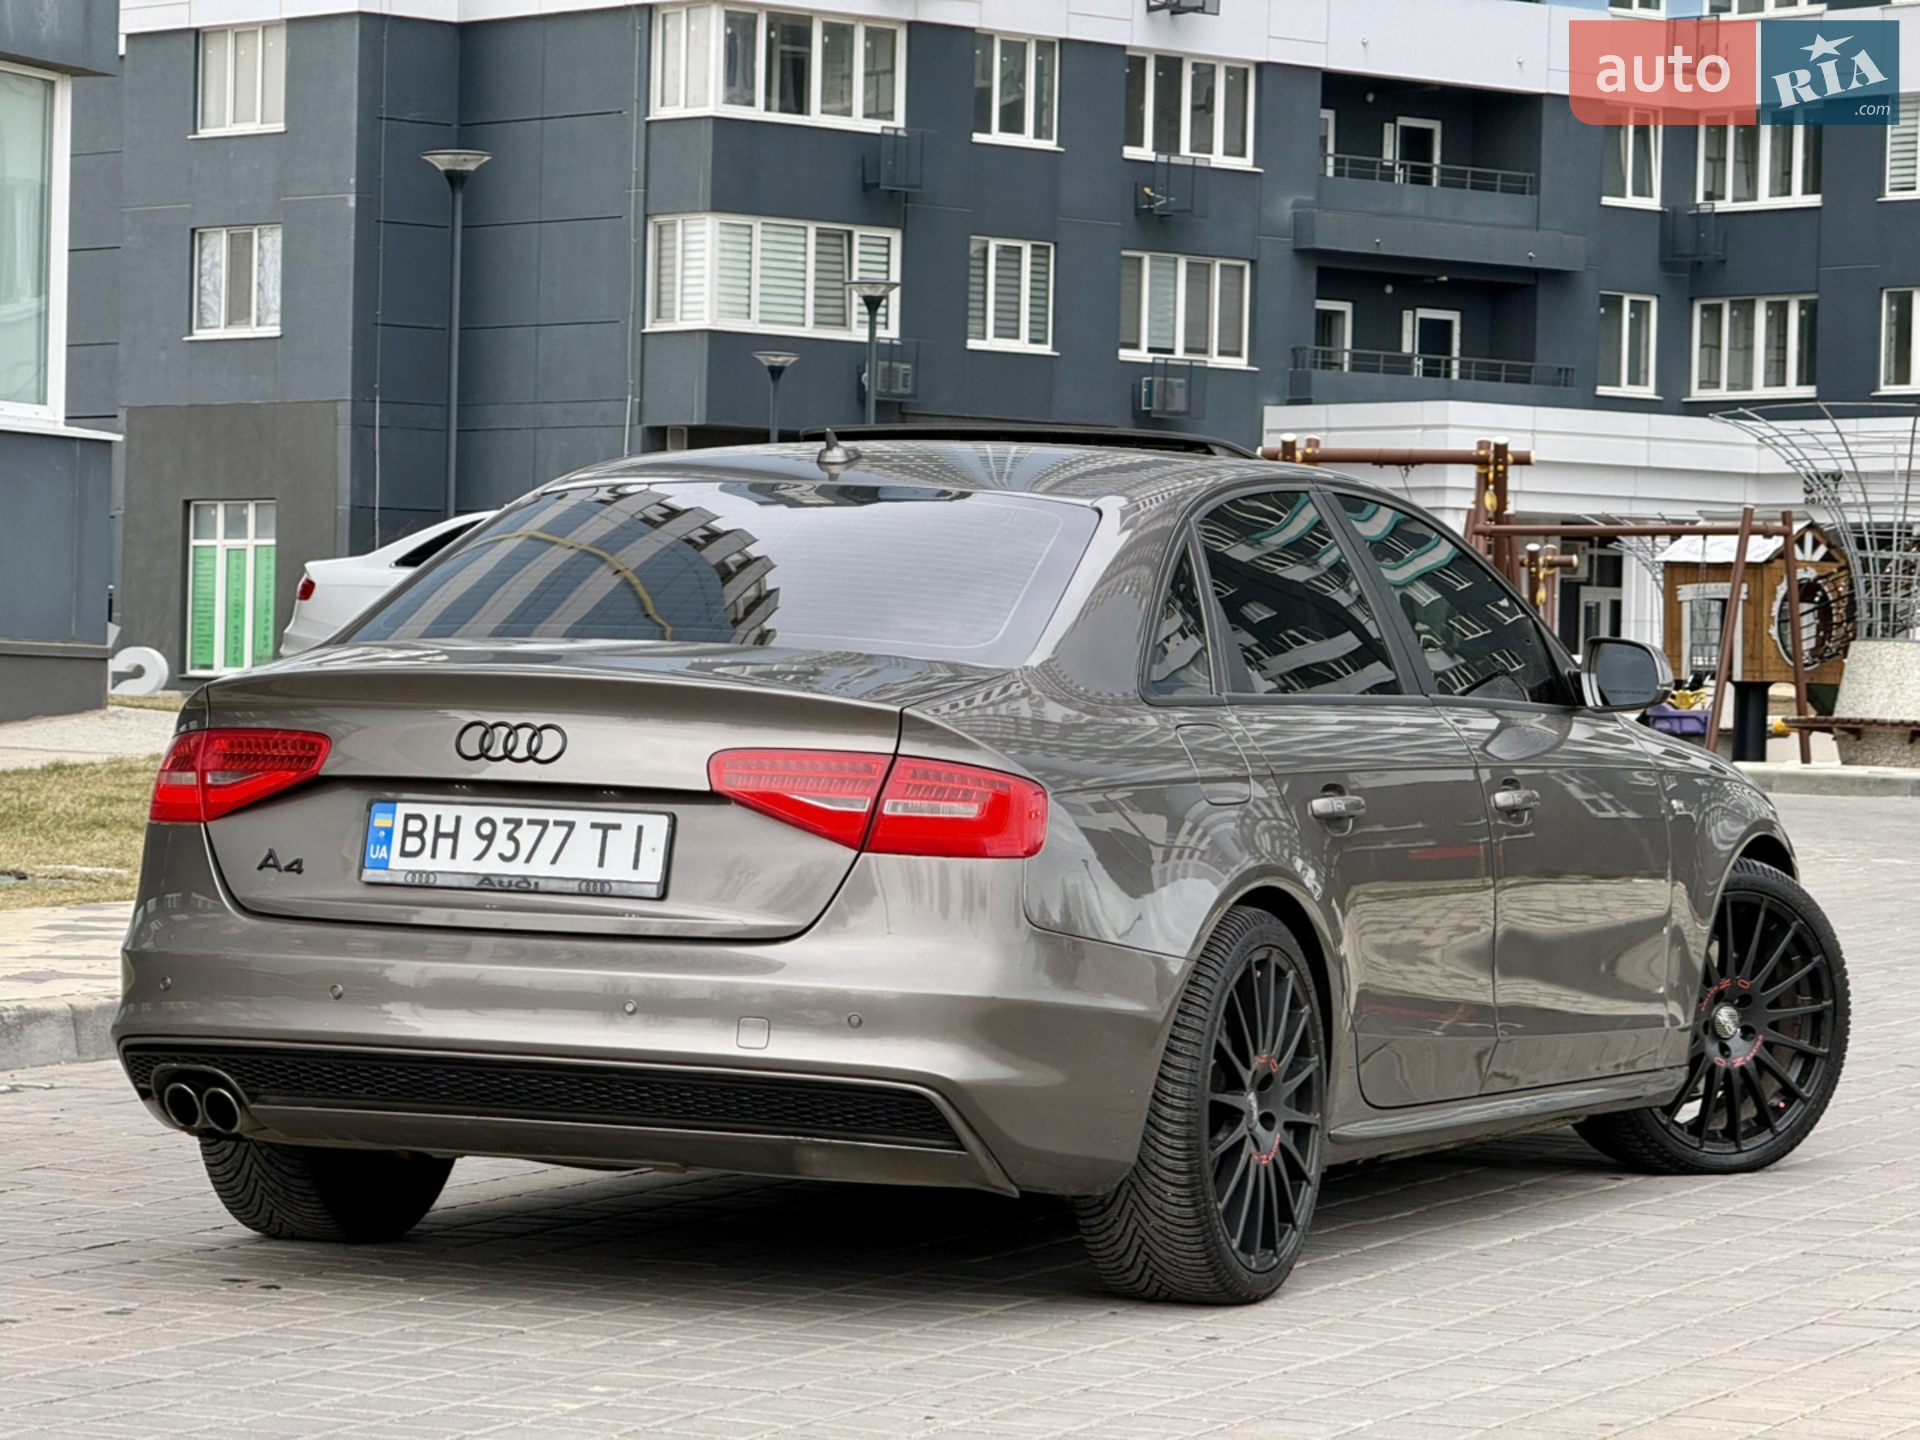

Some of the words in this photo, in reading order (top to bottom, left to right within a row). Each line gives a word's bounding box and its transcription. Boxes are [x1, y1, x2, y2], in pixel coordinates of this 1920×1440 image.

[369, 844, 388, 860] UA
[399, 813, 462, 860] BH
[472, 816, 577, 866] 9377
[590, 822, 645, 871] TI
[256, 848, 304, 875] A4
